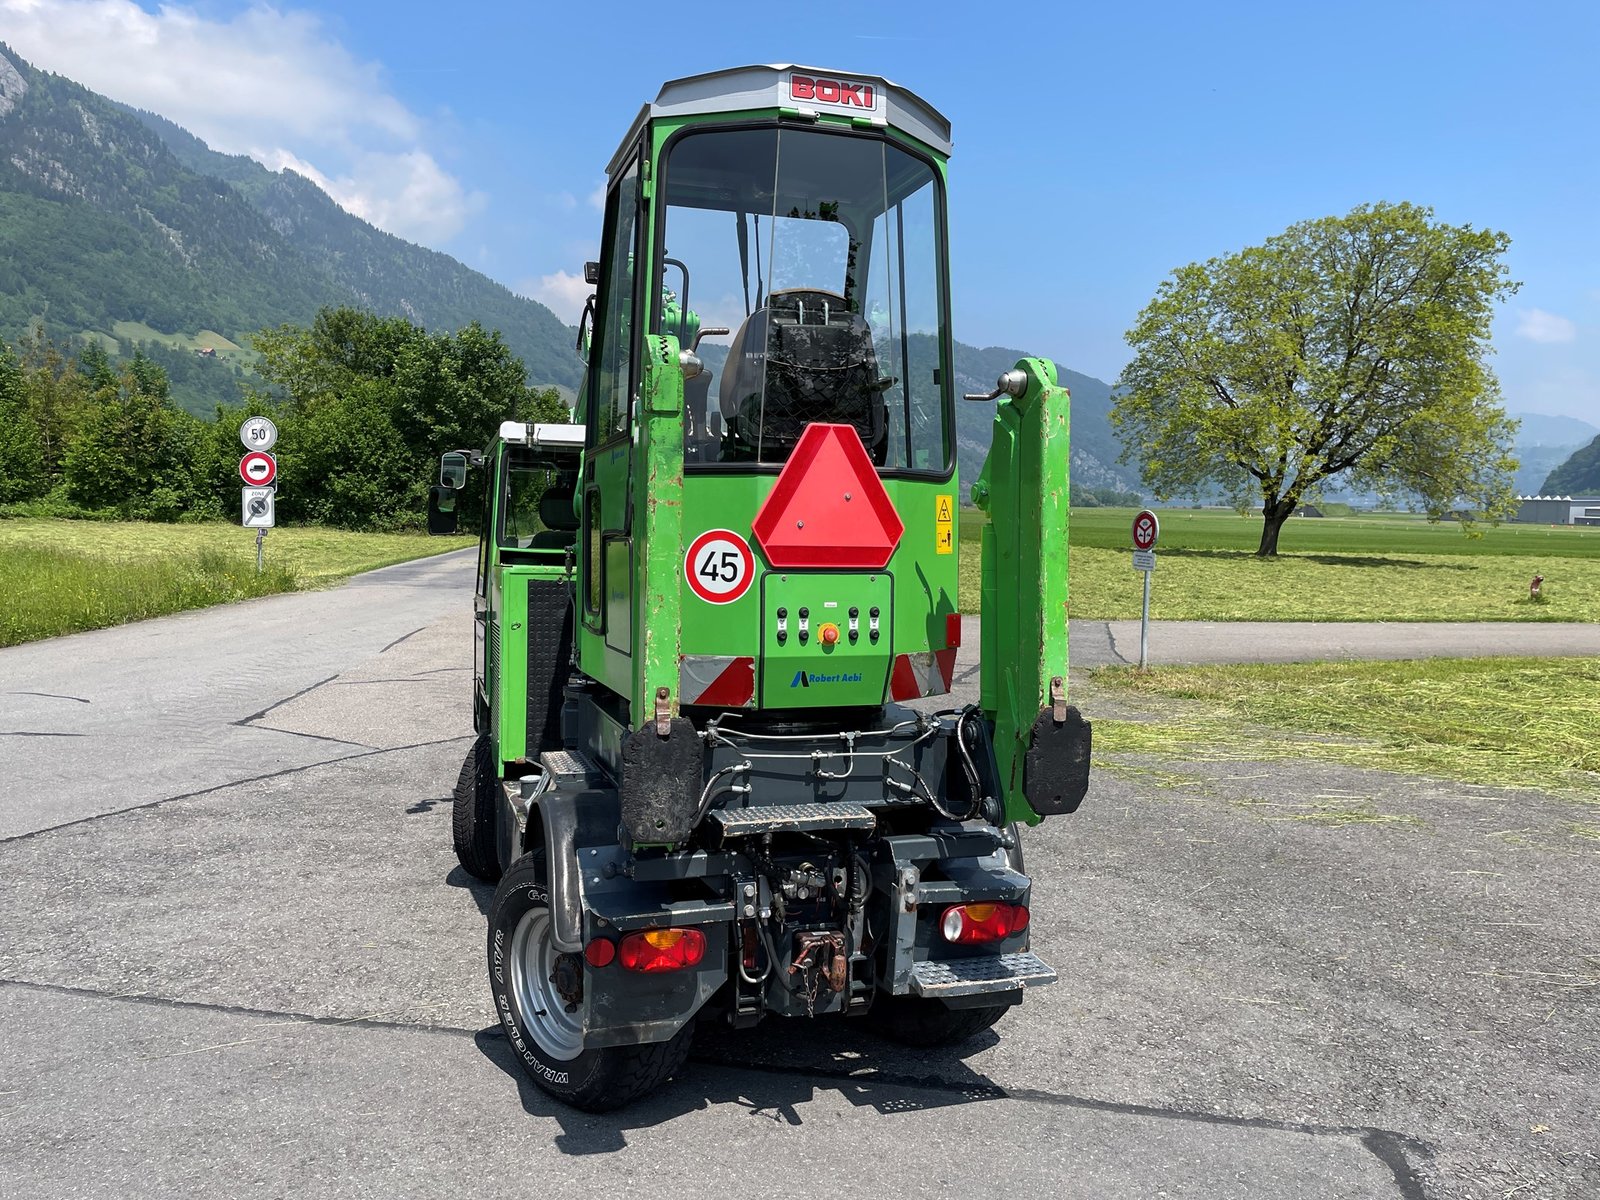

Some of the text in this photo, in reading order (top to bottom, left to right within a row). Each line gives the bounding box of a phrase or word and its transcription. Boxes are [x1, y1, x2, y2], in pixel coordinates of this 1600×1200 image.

[792, 75, 873, 108] BOKI
[251, 428, 266, 440] 50
[700, 551, 738, 583] 45
[809, 673, 862, 683] Robert Aebi
[499, 994, 569, 1084] WRANGLER
